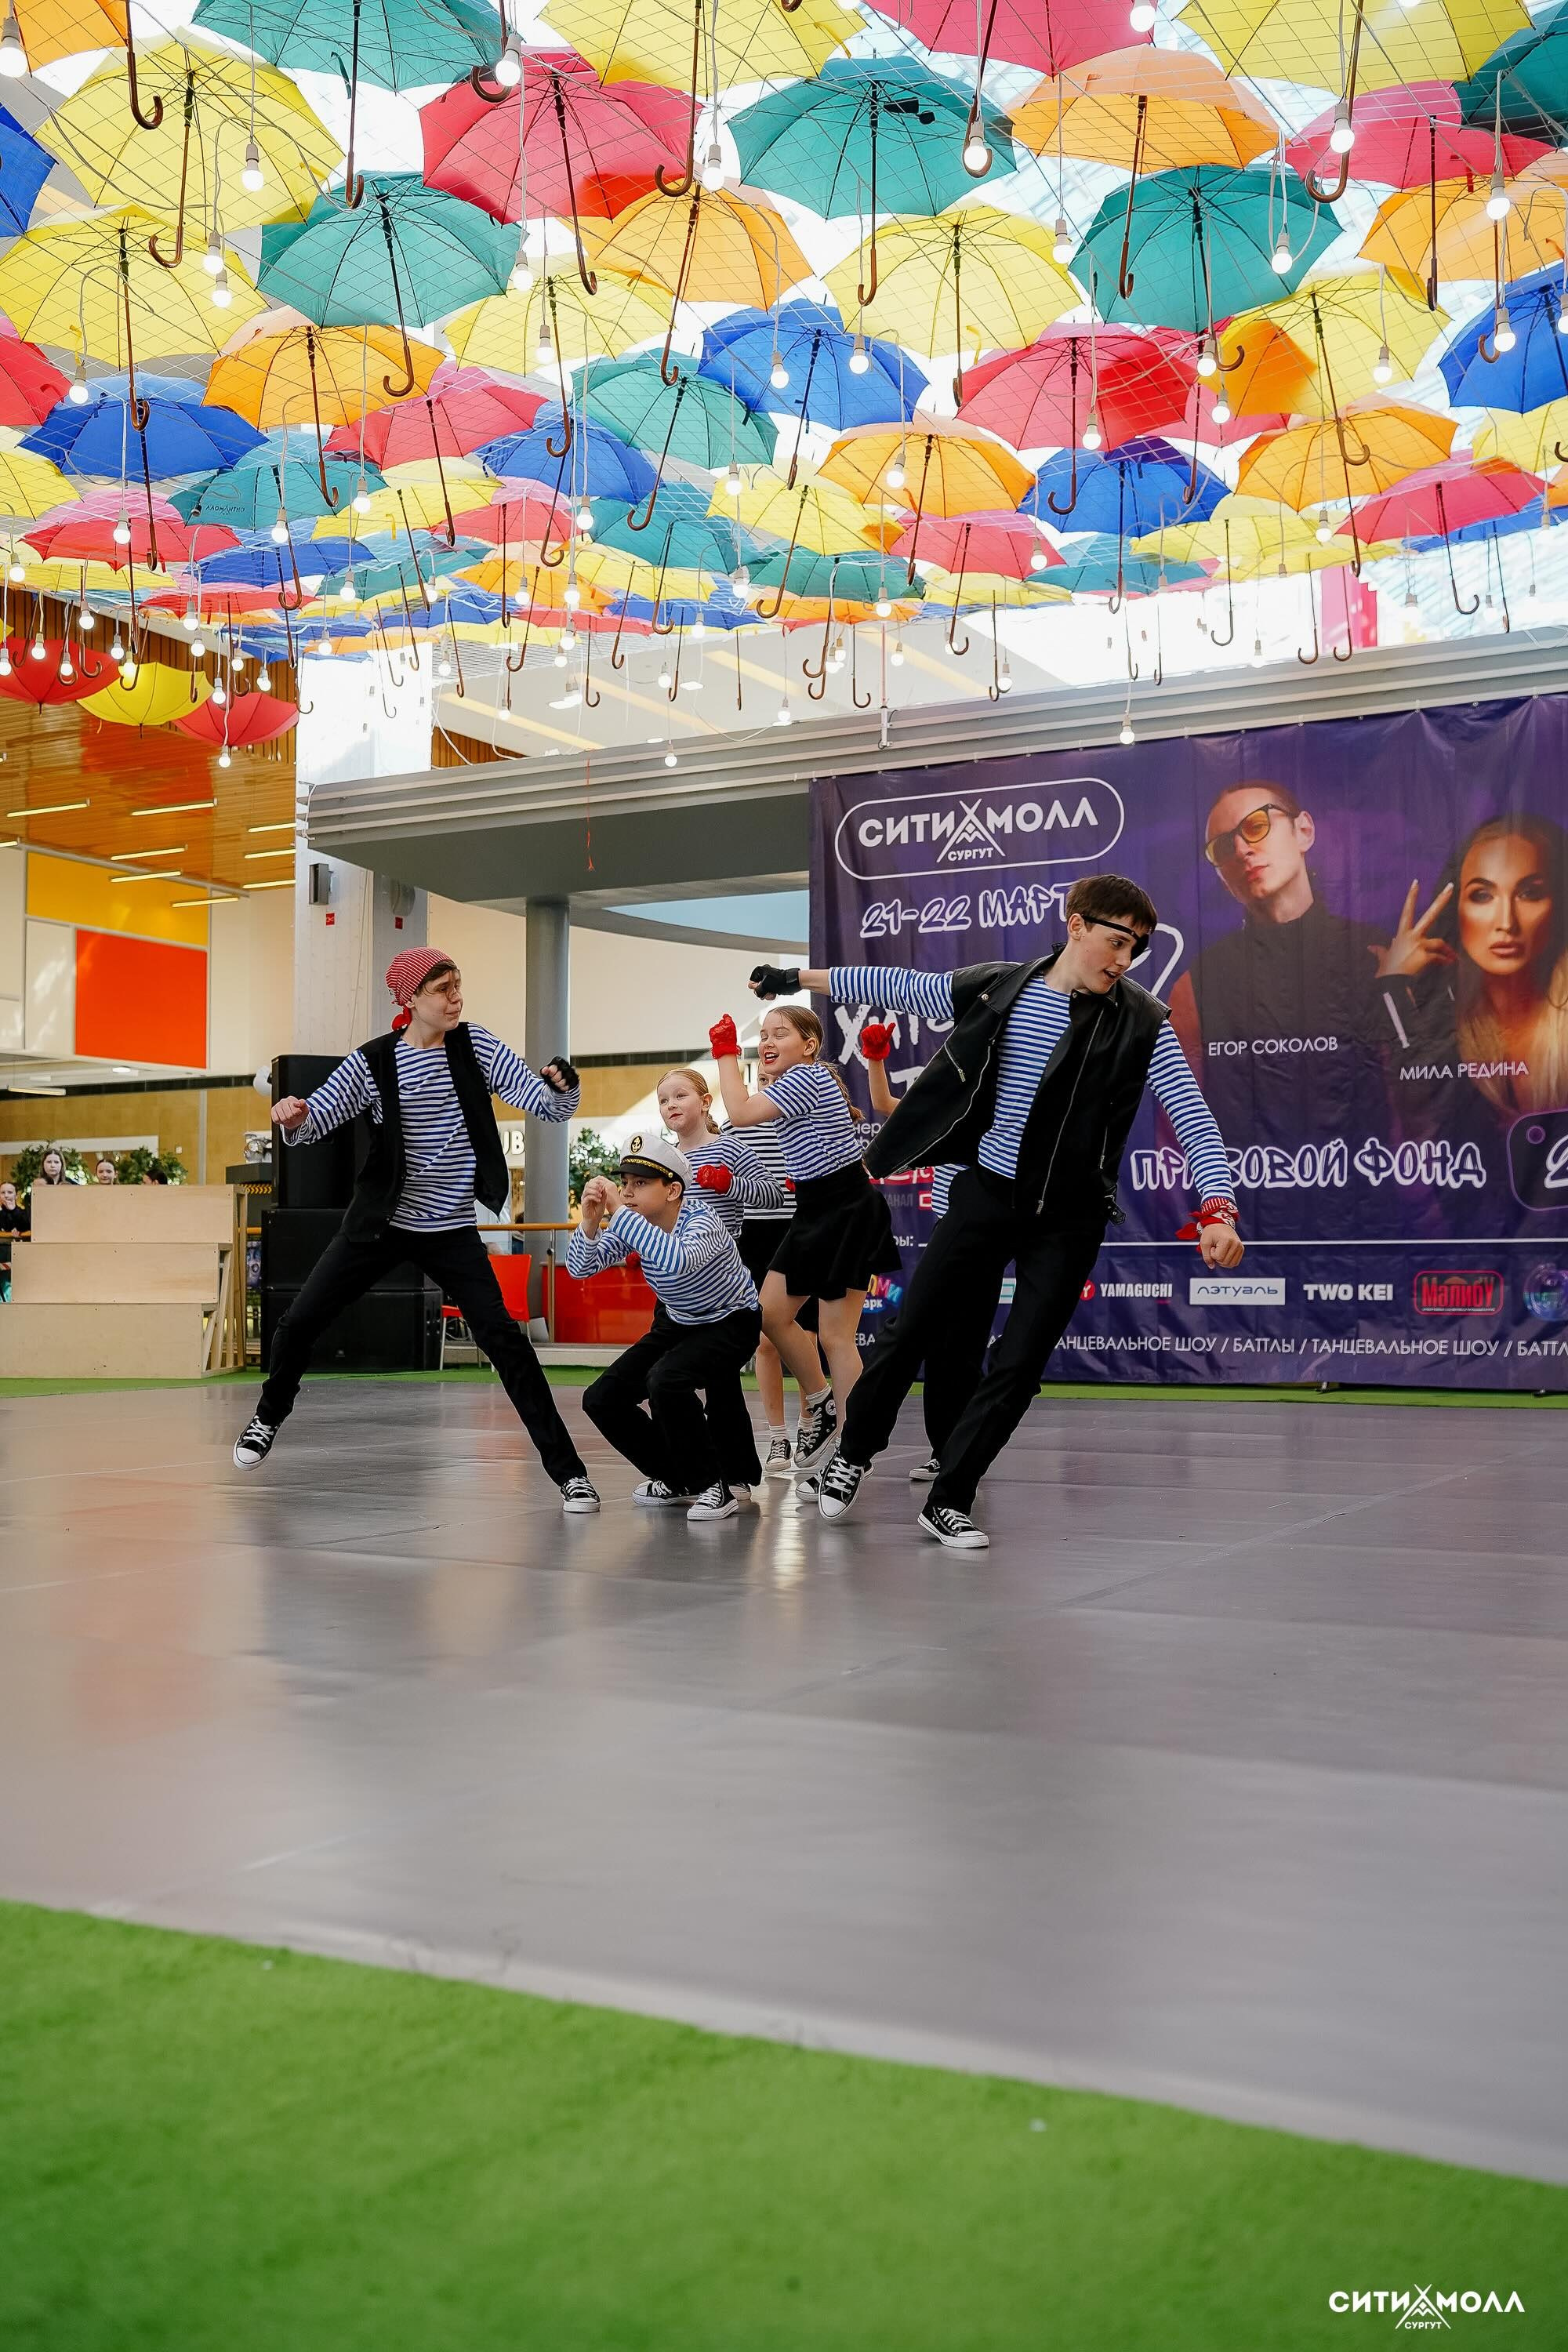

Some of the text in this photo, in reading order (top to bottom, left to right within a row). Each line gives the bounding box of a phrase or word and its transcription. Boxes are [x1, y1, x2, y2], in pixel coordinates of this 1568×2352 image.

[947, 847, 994, 862] СУРГУТ
[859, 883, 1074, 938] 21-22 МАРТ
[1208, 1036, 1339, 1057] ЕГОР СОКОЛОВ
[1399, 1062, 1530, 1081] МИЛА РЕДИНА
[1353, 1138, 1486, 1189] ФОНД
[1100, 1283, 1173, 1298] YAMAGUCHI
[1303, 1283, 1393, 1301] TWO KEI
[1054, 1336, 1171, 1352] АНЦЕВАЛЬНОЕ
[1175, 1336, 1218, 1352] ШОУ
[1311, 1338, 1449, 1356] ТАНЦЕВАЛЬНОЕ
[1453, 1339, 1500, 1356] ШОУ
[1517, 1340, 1568, 1356] БАТТЛ
